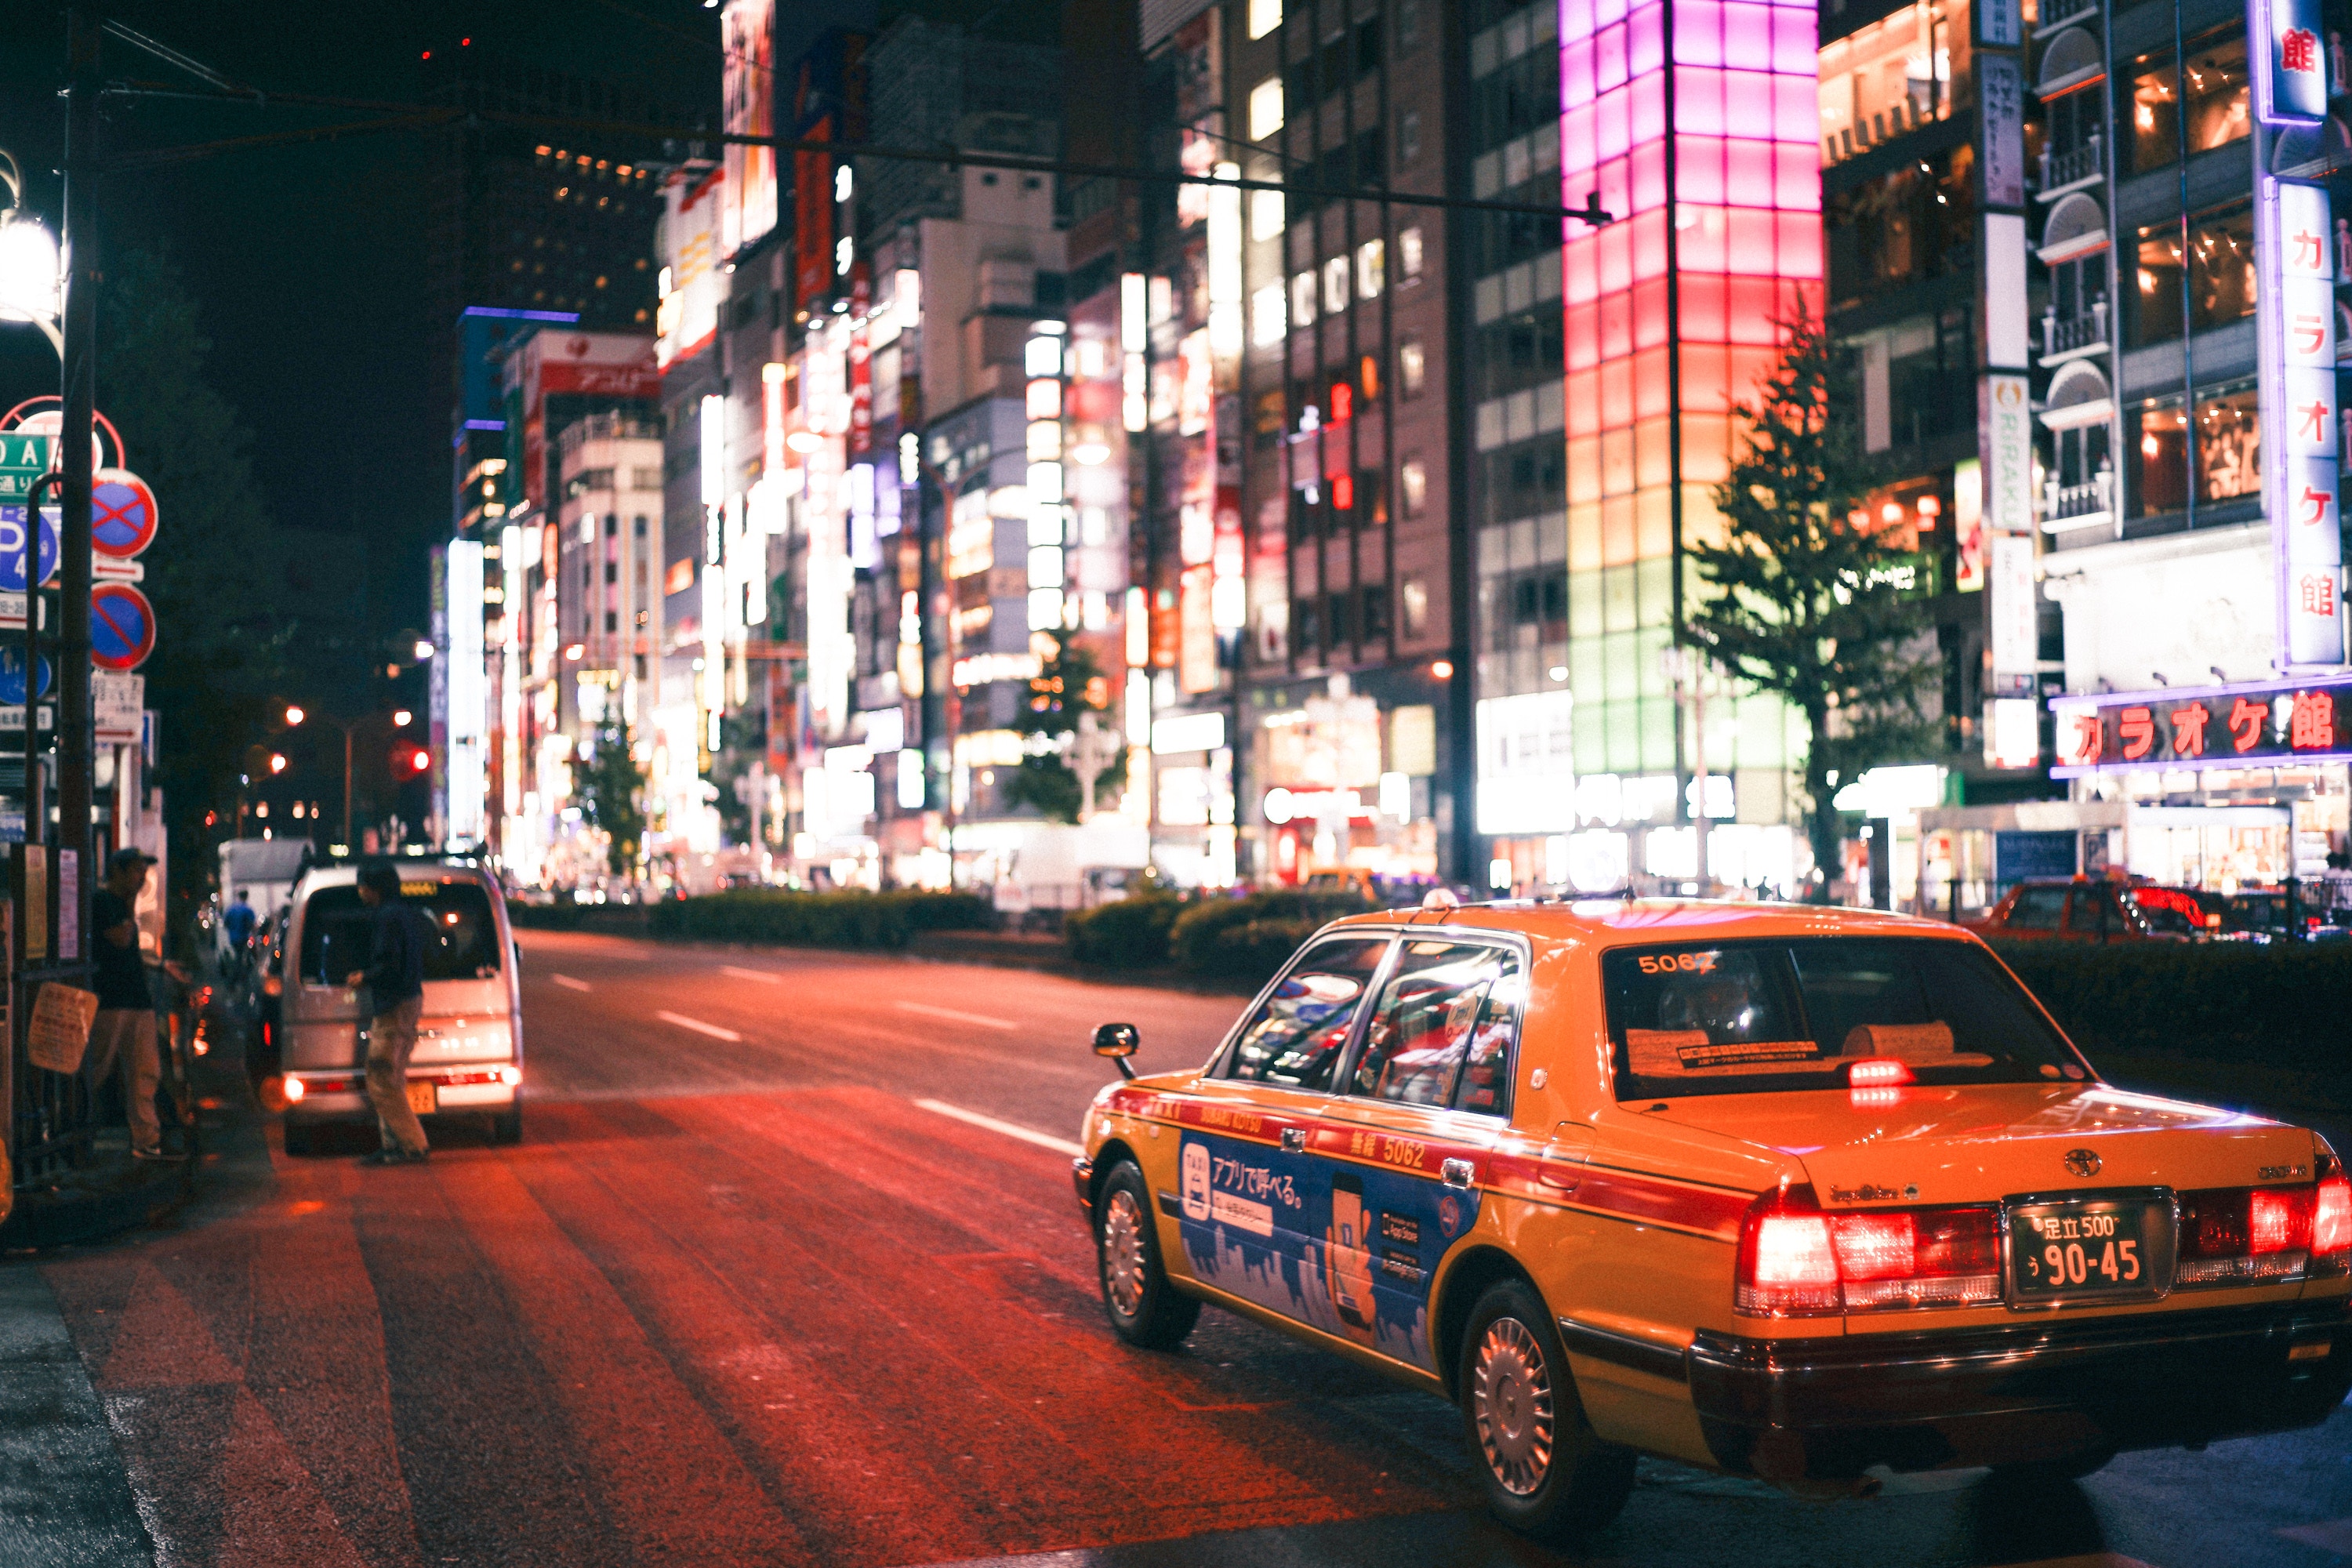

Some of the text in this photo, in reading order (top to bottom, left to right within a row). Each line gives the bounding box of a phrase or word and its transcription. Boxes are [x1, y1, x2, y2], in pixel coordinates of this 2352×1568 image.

[2292, 229, 2334, 617] カラオケ館
[2074, 690, 2334, 762] カラオケ館
[1639, 953, 1717, 975] 5062
[1384, 1138, 1425, 1168] 5062
[2045, 1240, 2140, 1286] 90-45
